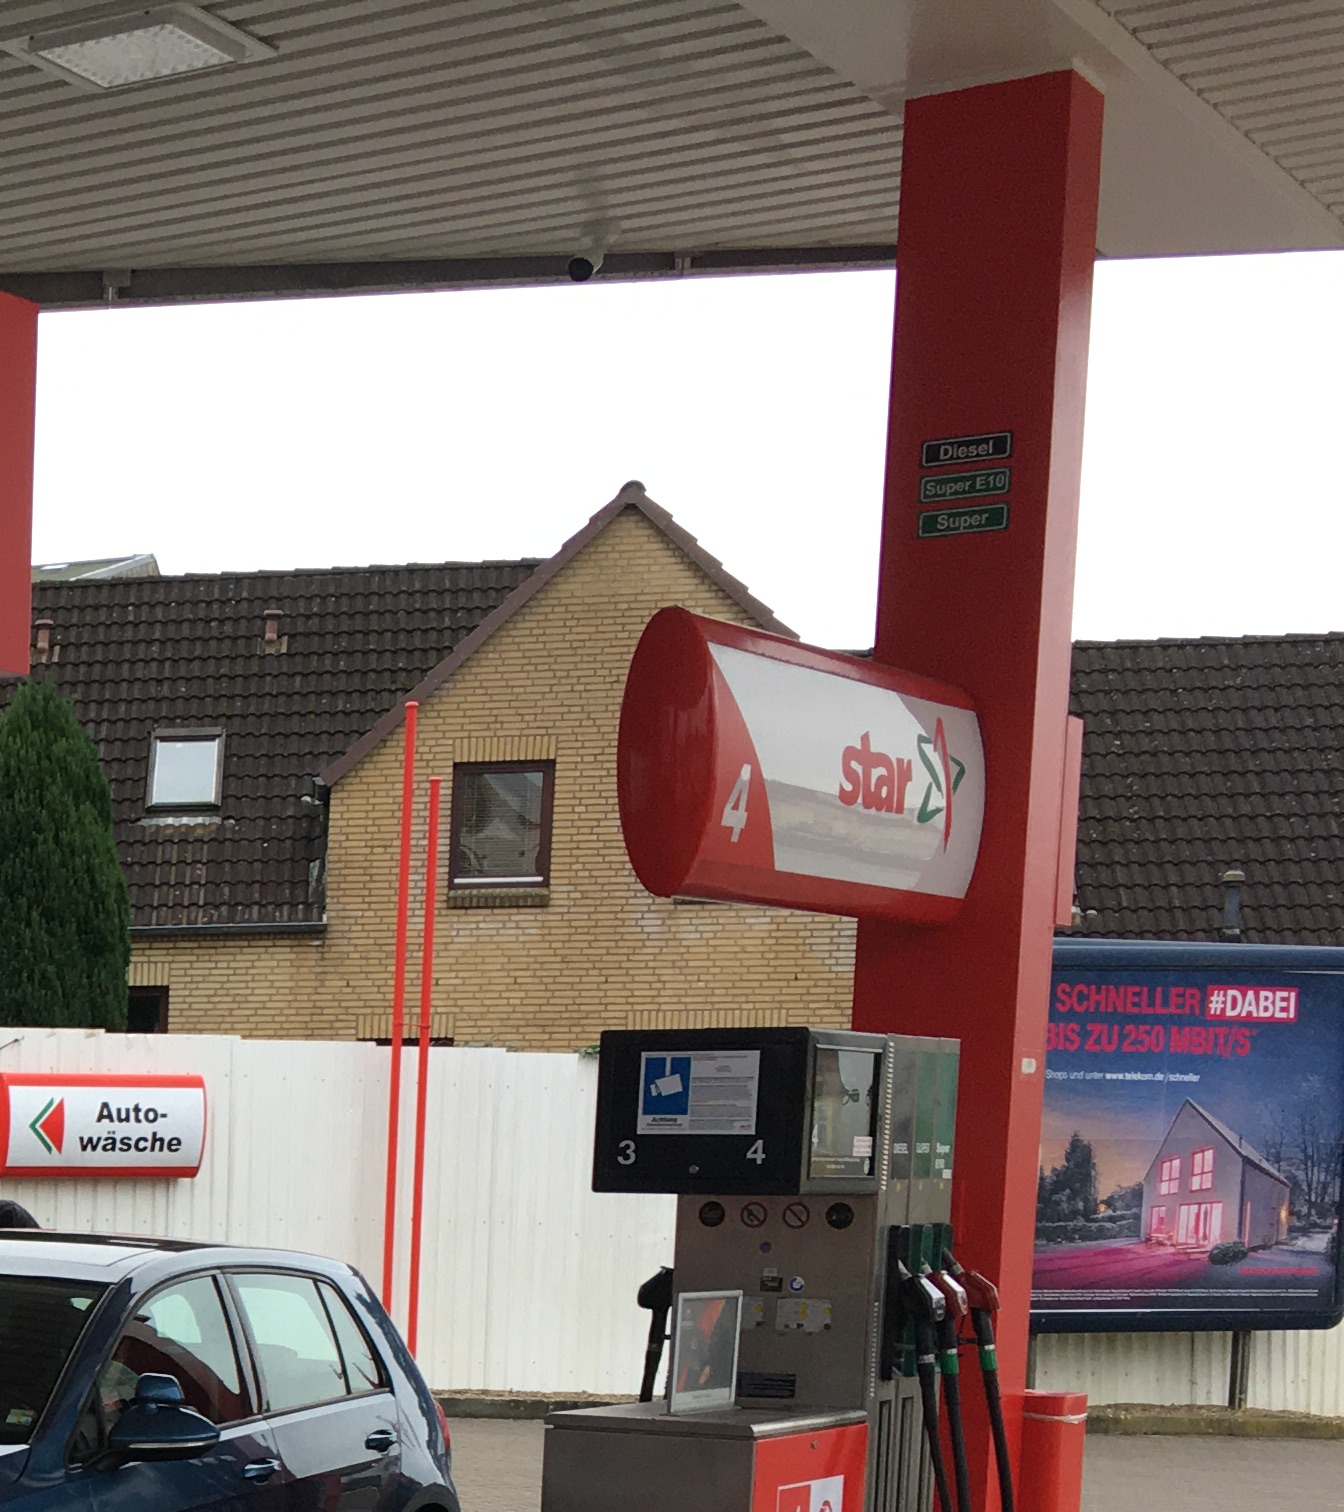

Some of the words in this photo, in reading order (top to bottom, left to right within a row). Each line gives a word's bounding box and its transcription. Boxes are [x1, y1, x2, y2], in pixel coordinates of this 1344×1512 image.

[939, 439, 994, 460] Diesel
[925, 480, 972, 496] Super
[975, 473, 1005, 490] E10
[936, 512, 990, 531] Super
[838, 731, 912, 815] star
[721, 763, 752, 843] 4
[1055, 982, 1201, 1016] SCHNELLER
[1208, 989, 1296, 1019] #DABEI
[1046, 1022, 1081, 1050] BIS
[1085, 1022, 1119, 1051] ZU
[1121, 1025, 1165, 1053] 250
[1046, 1069, 1068, 1080] Shops
[1069, 1069, 1084, 1079] und
[1085, 1071, 1104, 1080] unter
[95, 1101, 168, 1124] Auto-
[79, 1130, 182, 1153] wäsche
[617, 1139, 637, 1165] 3
[746, 1139, 766, 1165] 4
